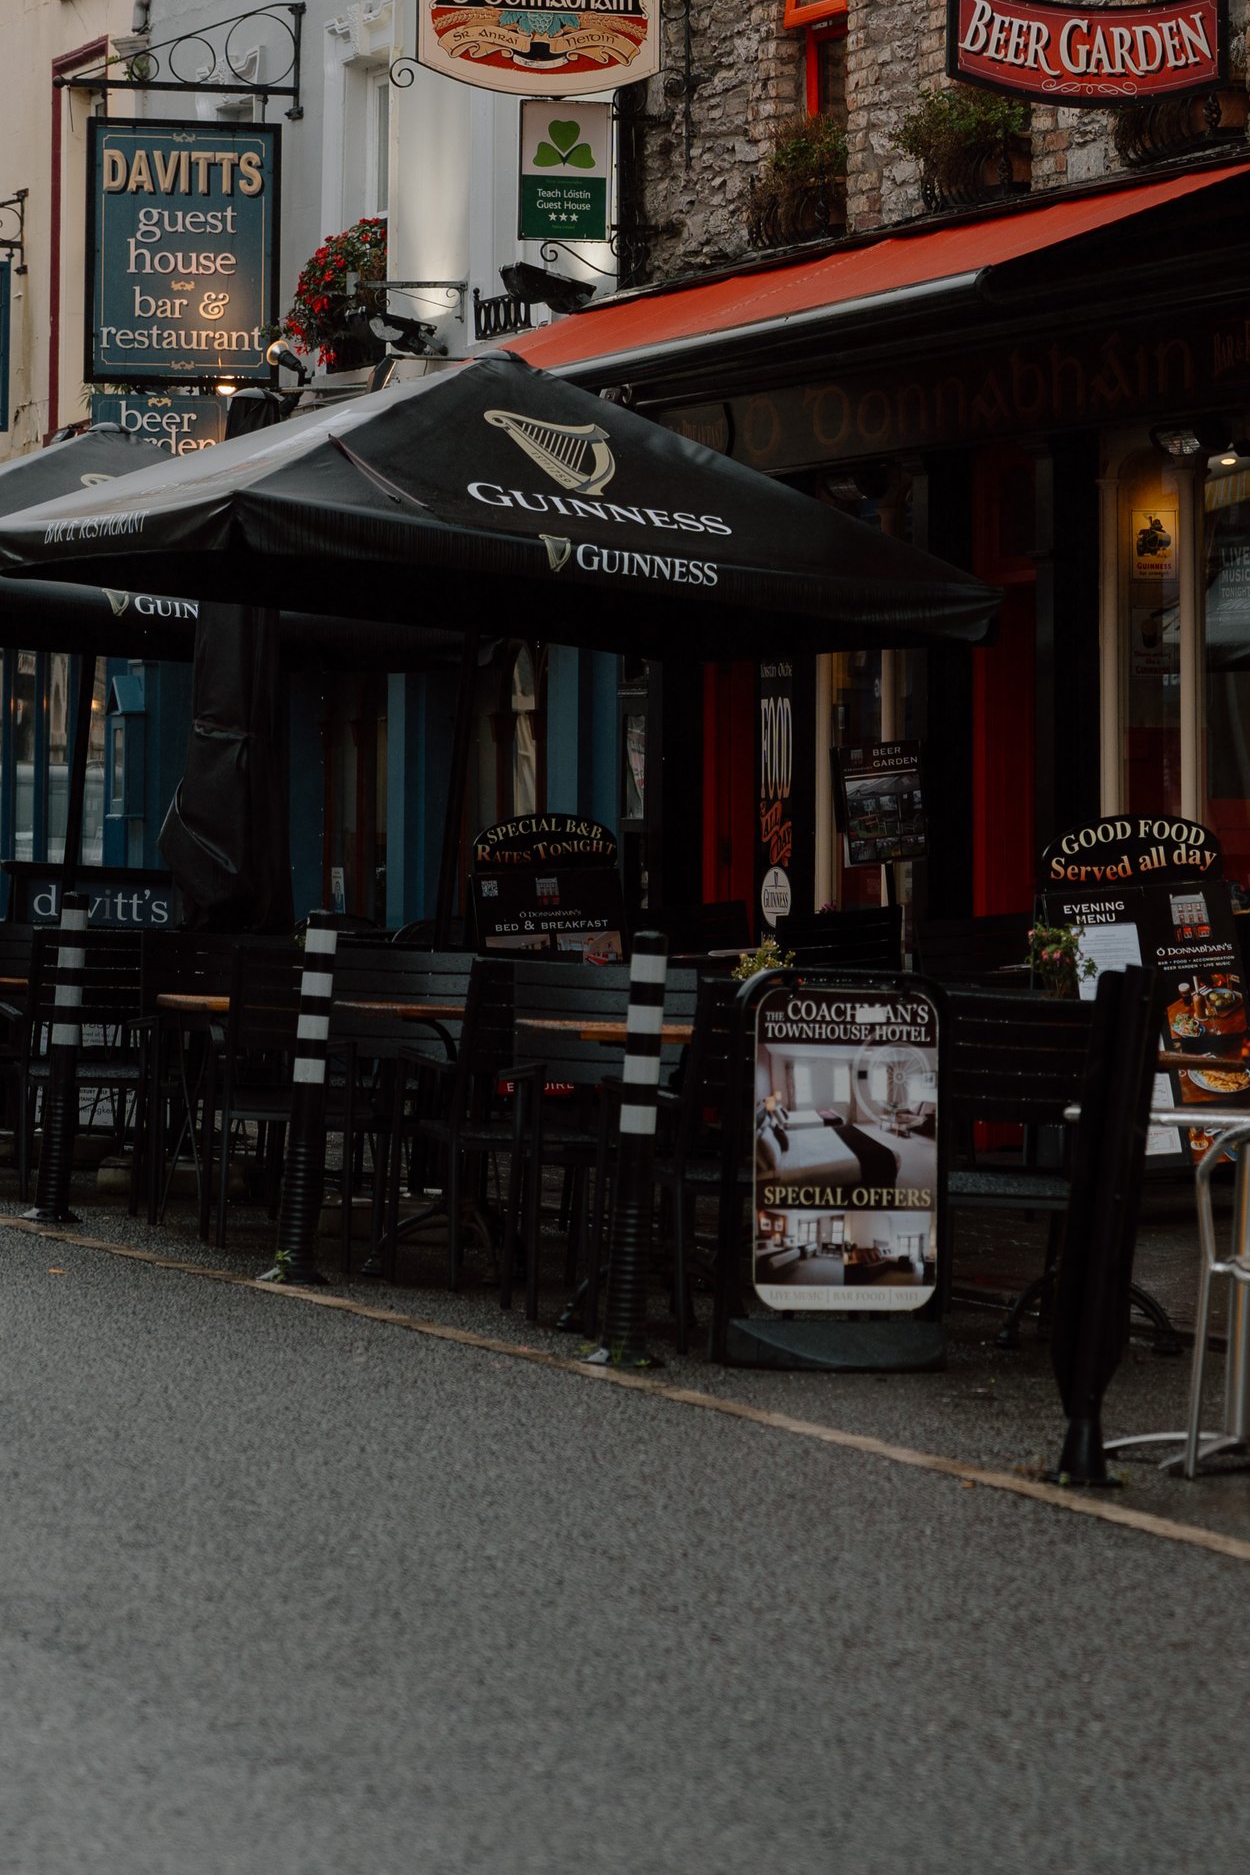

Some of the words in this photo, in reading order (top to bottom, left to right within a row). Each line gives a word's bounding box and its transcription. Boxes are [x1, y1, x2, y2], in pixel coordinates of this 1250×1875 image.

[1058, 11, 1212, 78] GARDEN
[103, 149, 263, 195] DAVITTS
[536, 200, 562, 210] Guest
[563, 201, 591, 211] House
[537, 188, 561, 199] Teach
[136, 206, 237, 243] guest
[127, 238, 236, 275] house
[133, 285, 188, 318] bar
[199, 292, 229, 320] &
[100, 325, 263, 352] restaurant
[120, 400, 197, 432] beer
[467, 482, 733, 535] GUINNESS
[44, 521, 63, 544] BAR
[66, 522, 75, 541] &
[79, 511, 149, 539] RESTAURANT
[576, 543, 718, 587] GUINNESS
[1137, 562, 1172, 570] GUINNESS
[1222, 546, 1250, 566] LIVE
[1222, 569, 1250, 582] MUSIC
[760, 696, 793, 799] FOOD
[872, 747, 901, 756] BEER
[873, 756, 918, 767] GARDEN
[487, 818, 561, 844] SPECIAL
[565, 819, 603, 840] B&B
[1061, 820, 1132, 855] GOOD
[1138, 819, 1205, 846] FOOD
[475, 844, 532, 864] RATES
[533, 840, 616, 862] TONIGHT
[1050, 855, 1133, 882] Served
[1139, 845, 1166, 872] all
[1172, 843, 1216, 871] day
[33, 885, 169, 922] dvitt's
[764, 889, 789, 908] GUINNESS
[1063, 901, 1125, 914] EVENING
[495, 923, 519, 932] BED
[524, 920, 535, 931] &
[541, 919, 609, 931] BREAKFAST
[1076, 913, 1116, 924] MENU
[765, 1011, 785, 1021] THE
[787, 1000, 929, 1024] COACHAN'S
[765, 1023, 870, 1040] TOWNHOUSE
[875, 1025, 930, 1042] HOTEL
[764, 1186, 848, 1207] SPECIAL
[852, 1187, 931, 1208] OFFERS
[770, 1290, 790, 1300] LIVE
[833, 1291, 853, 1301] BAR
[856, 1291, 886, 1301] FOOD
